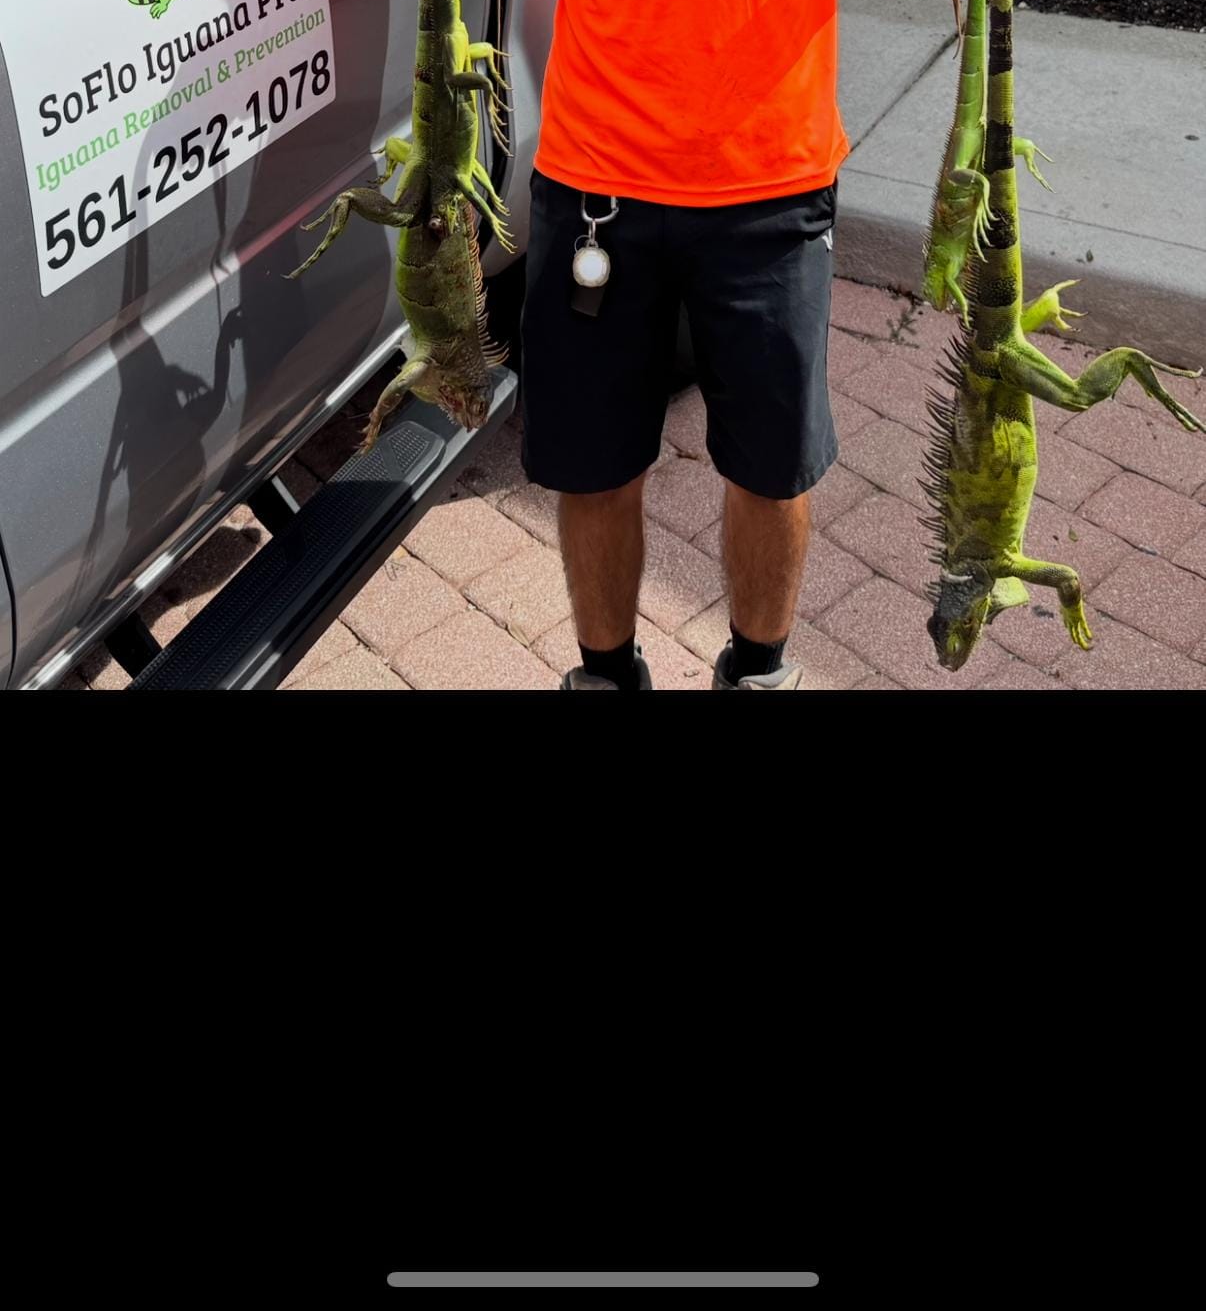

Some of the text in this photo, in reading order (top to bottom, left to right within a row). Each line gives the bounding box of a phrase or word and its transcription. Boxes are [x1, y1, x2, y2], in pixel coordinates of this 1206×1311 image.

[35, 8, 326, 192] Iguana Removal & Prevention
[39, 61, 137, 138] SoFlo
[143, 2, 252, 84] Iguana
[45, 49, 331, 270] 561-252-1078
